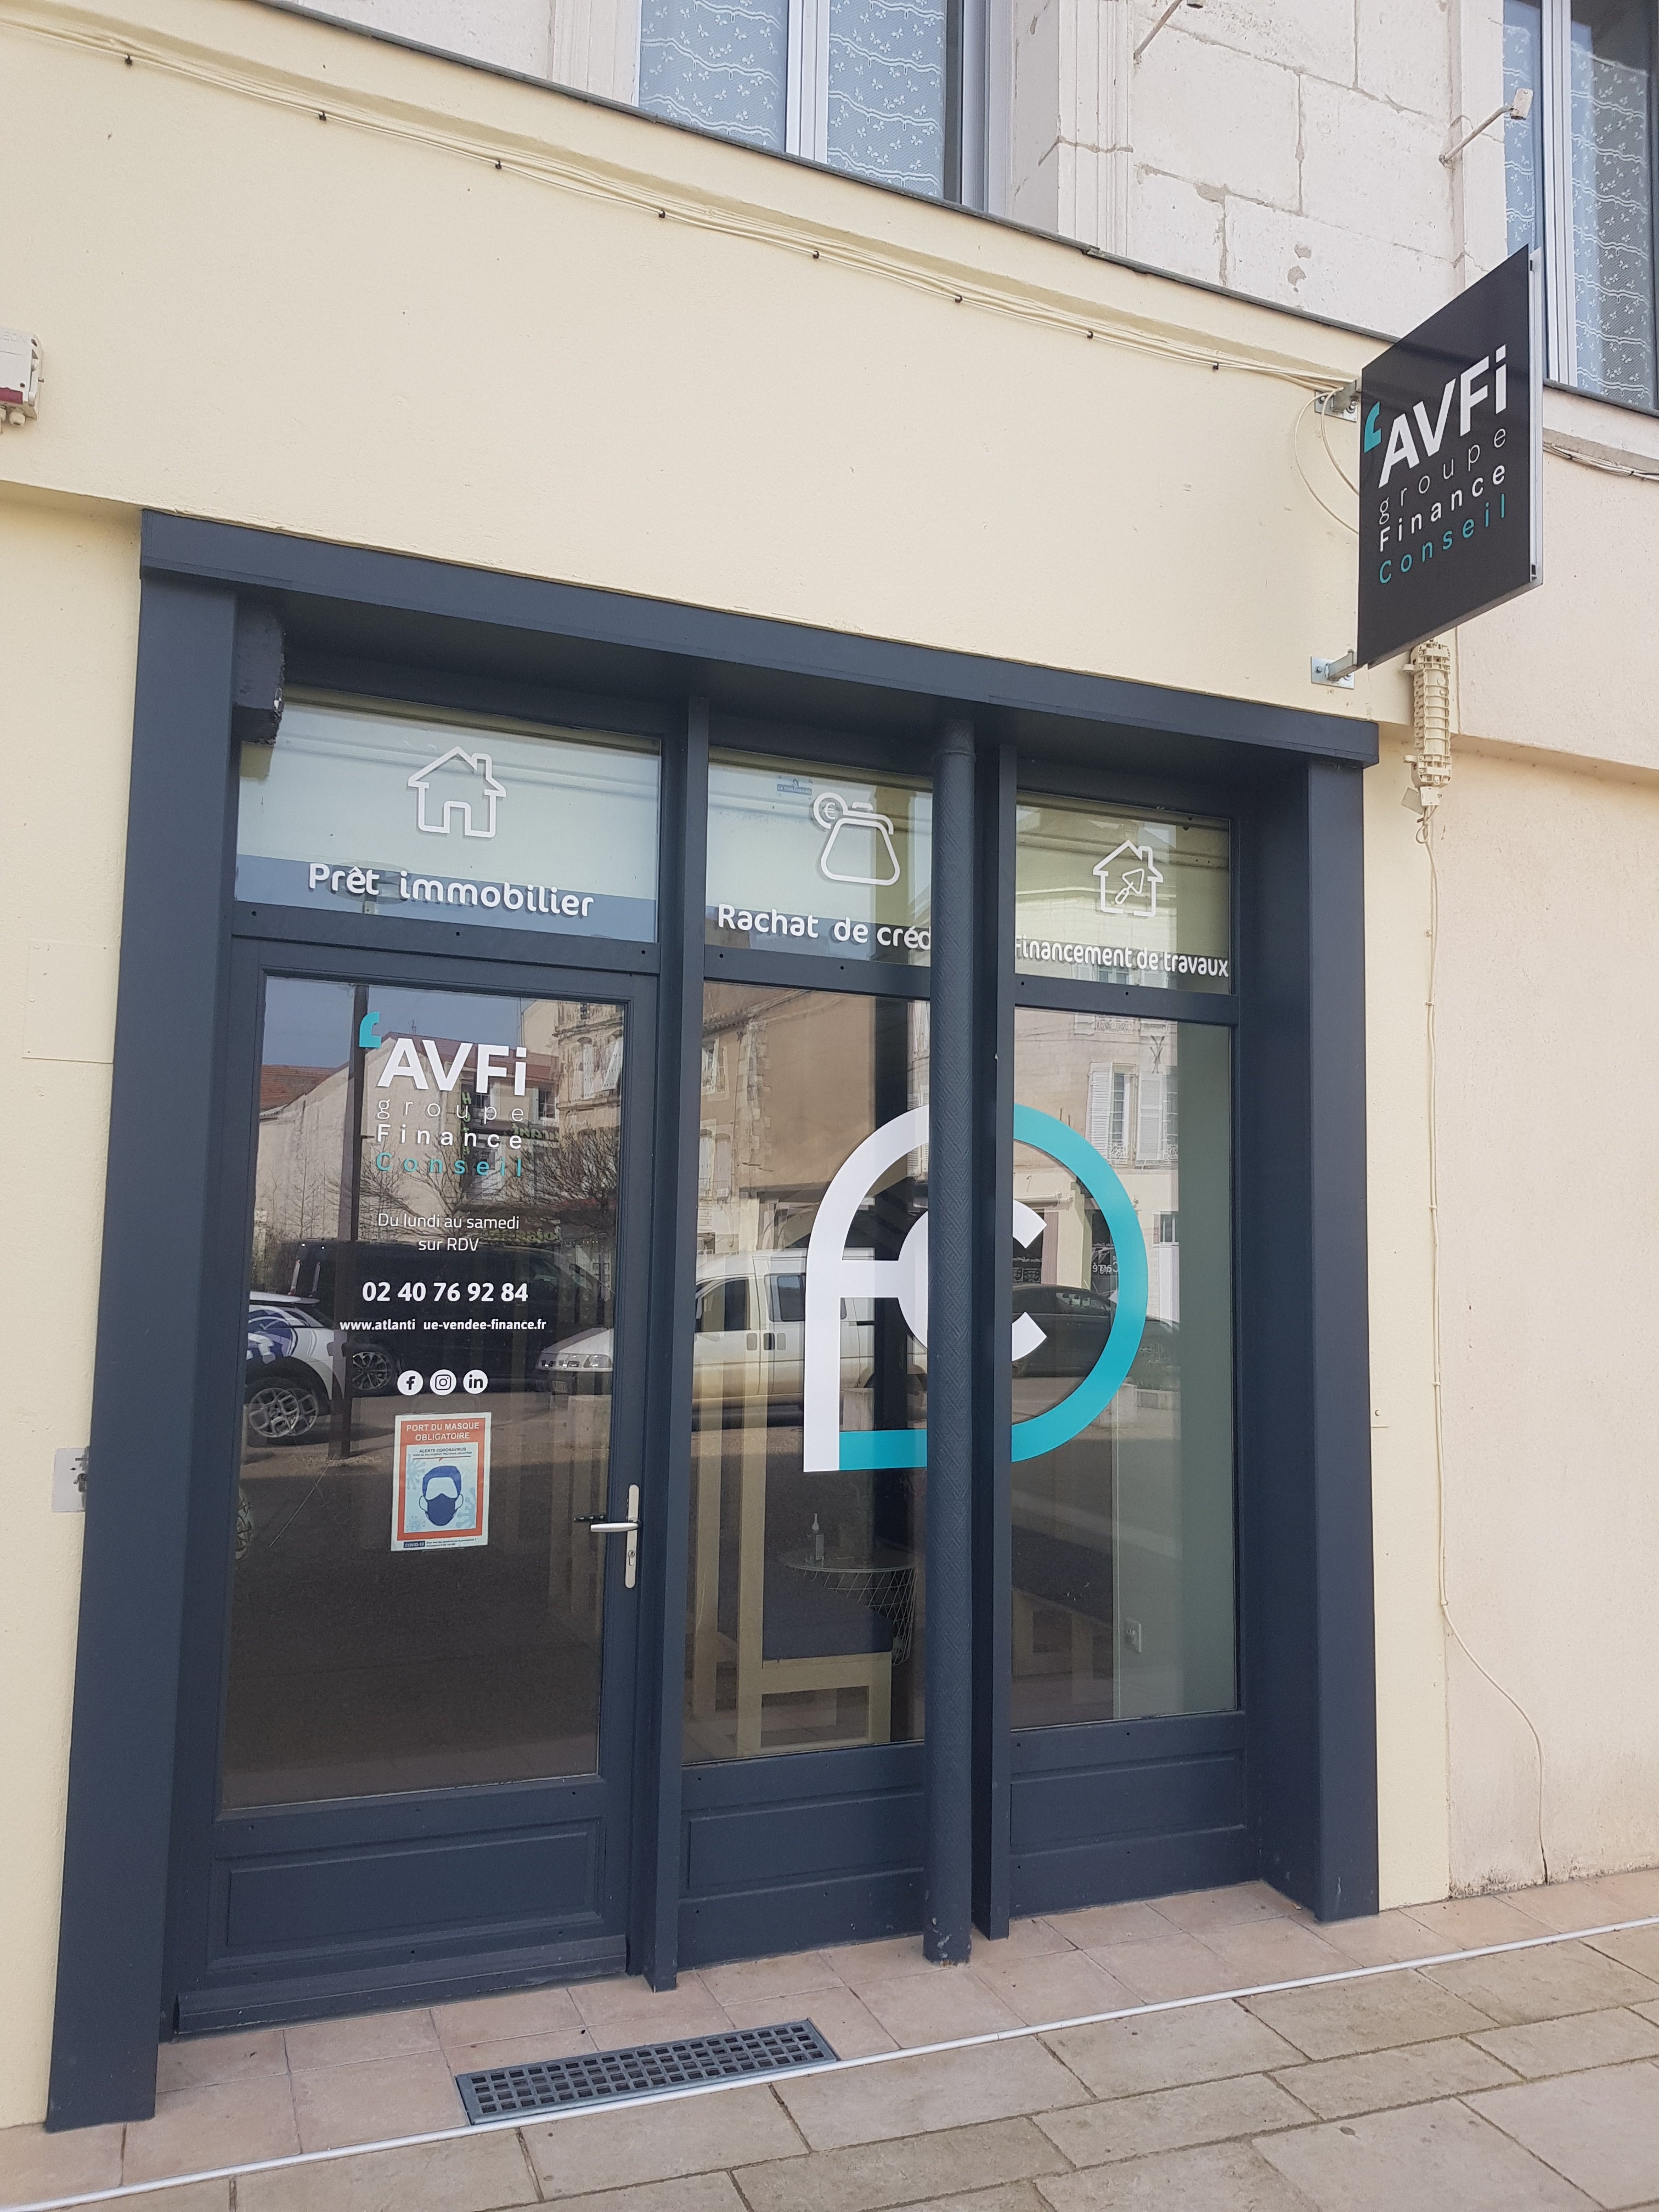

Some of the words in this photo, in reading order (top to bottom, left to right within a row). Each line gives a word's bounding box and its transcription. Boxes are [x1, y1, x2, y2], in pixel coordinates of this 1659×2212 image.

[1379, 344, 1506, 488] AVFi
[1379, 428, 1506, 525] groupe
[1380, 465, 1505, 552] Finance
[1379, 494, 1505, 584] Conseil
[309, 863, 380, 895] Prêt
[400, 870, 594, 917] immobilier
[718, 903, 819, 938] Rachat
[833, 917, 868, 944] de
[1137, 947, 1158, 970] de
[1164, 951, 1229, 978] travaux
[377, 1037, 527, 1096] AVFi
[376, 1098, 524, 1125] groupe
[377, 1124, 522, 1149] Finance
[376, 1152, 522, 1177] Conseil
[378, 1213, 399, 1227] Du
[404, 1213, 440, 1227] lundi
[444, 1216, 462, 1228] au
[466, 1216, 520, 1229] samedi
[418, 1237, 443, 1251] sur
[447, 1238, 479, 1252] RDV
[363, 1282, 391, 1301] 02
[397, 1282, 426, 1302] 40
[433, 1282, 460, 1302] 76
[467, 1283, 494, 1302] 92
[501, 1283, 528, 1302] 84
[415, 1432, 470, 1441] OBLIGATOIRE
[445, 1422, 479, 1430] MASQUE
